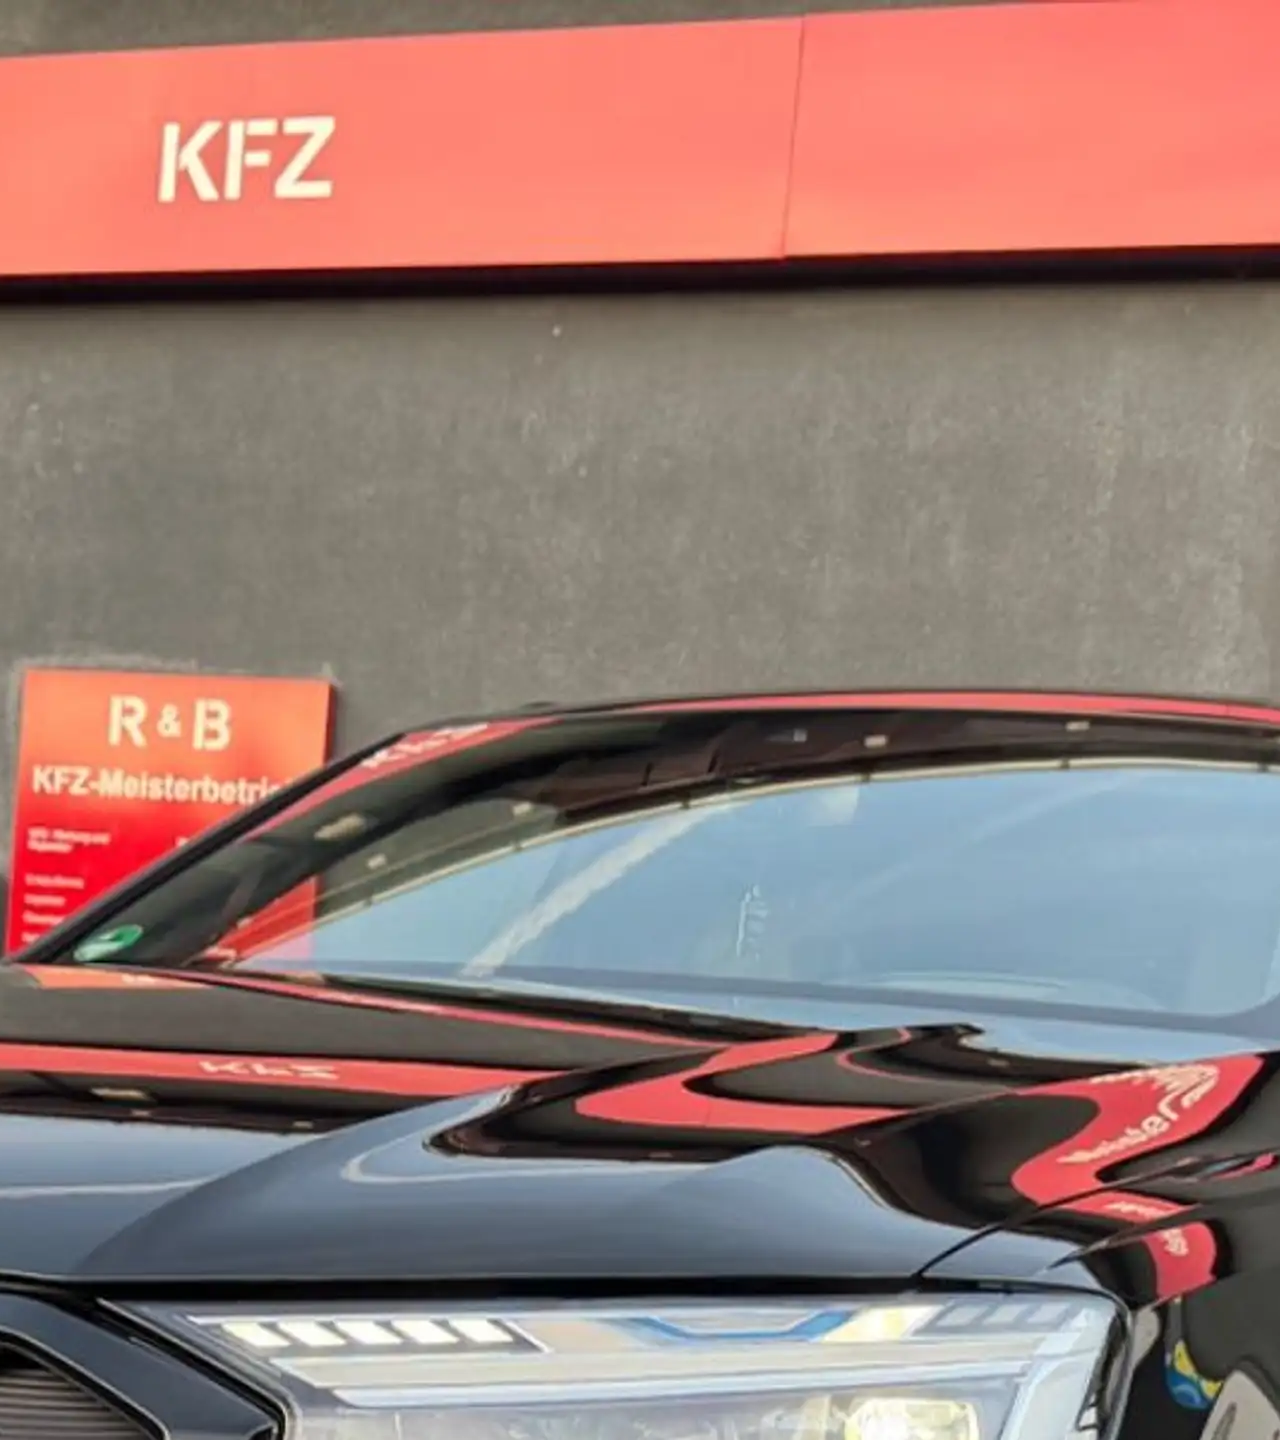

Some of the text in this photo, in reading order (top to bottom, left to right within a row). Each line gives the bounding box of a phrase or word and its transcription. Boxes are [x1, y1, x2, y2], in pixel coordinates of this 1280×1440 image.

[158, 115, 336, 203] KFZ
[107, 694, 232, 751] R & B
[31, 764, 293, 805] KFZ-Meisterbetri
